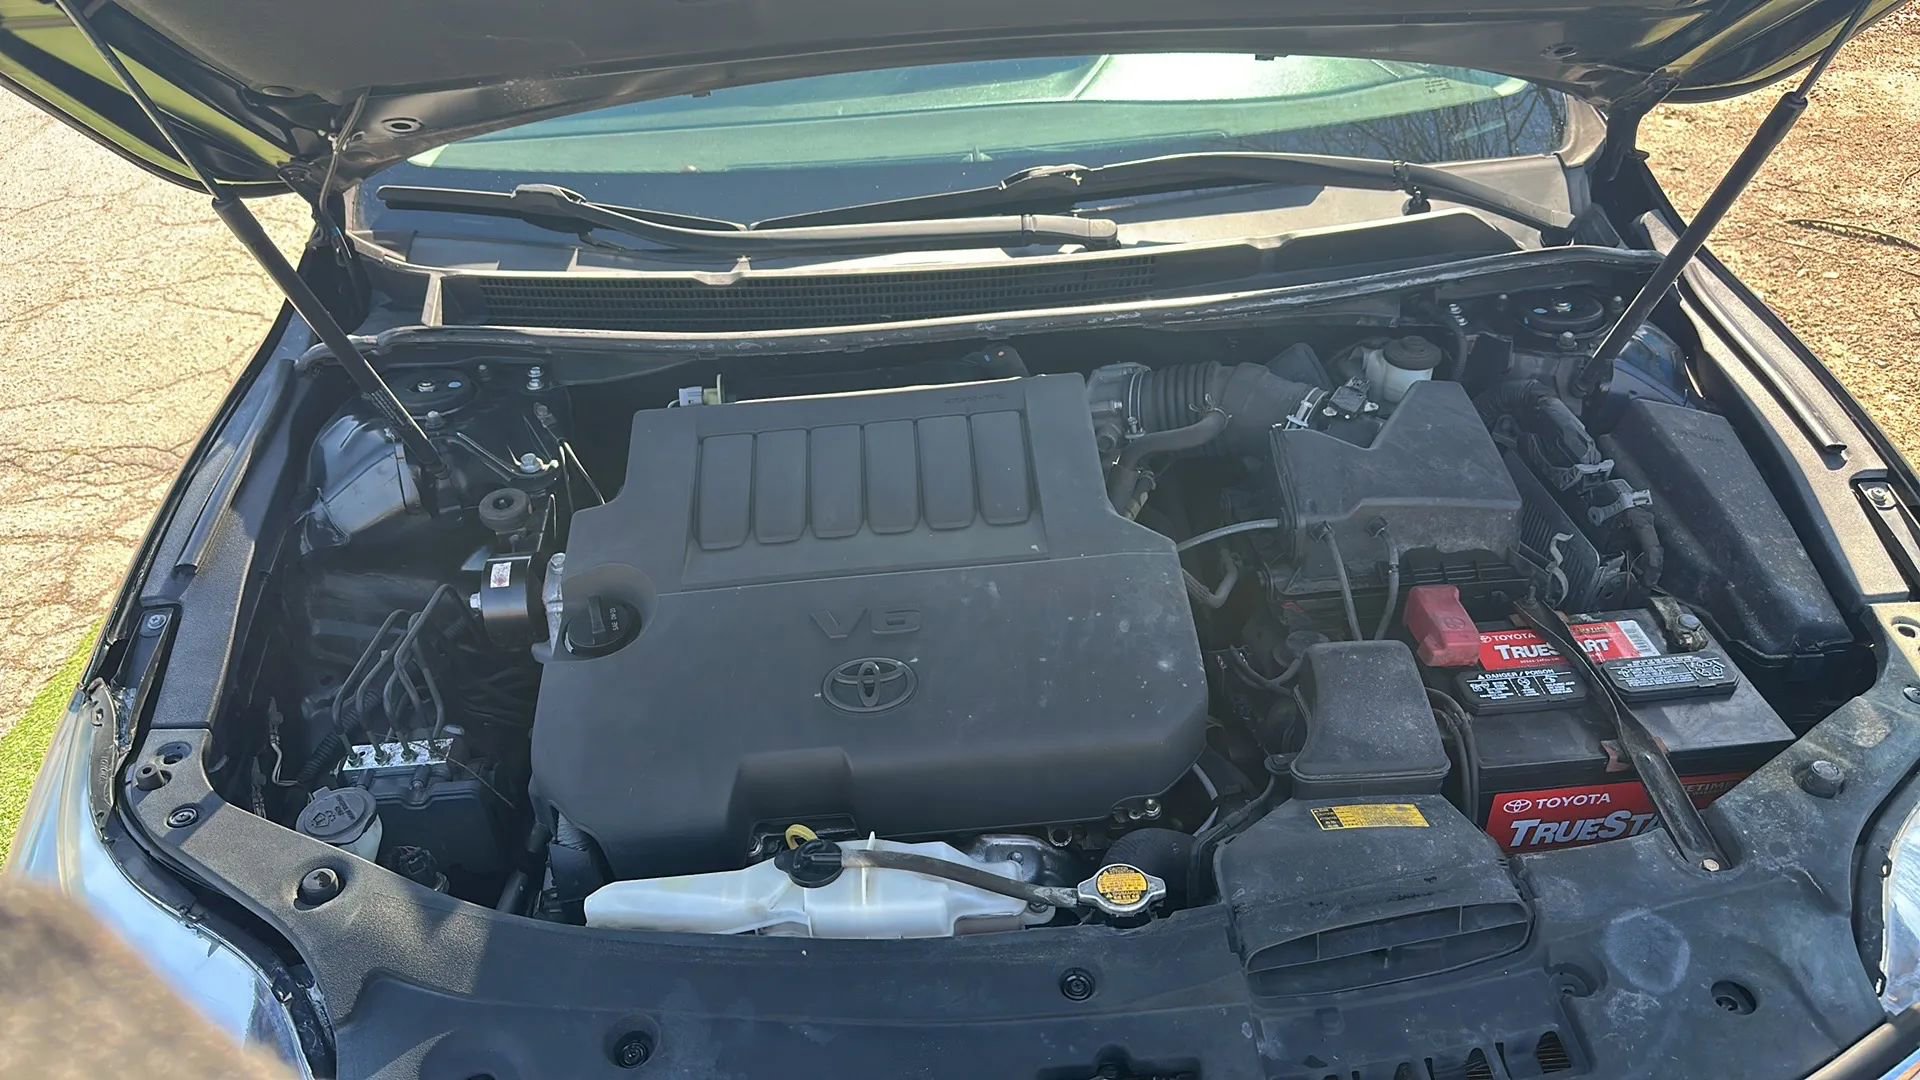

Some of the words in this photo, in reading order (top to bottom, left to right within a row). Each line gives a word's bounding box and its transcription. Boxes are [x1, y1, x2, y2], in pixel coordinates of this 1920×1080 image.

[808, 607, 921, 639] V6
[1491, 632, 1537, 641] TOYOTA
[1485, 671, 1518, 679] DANGER
[1525, 668, 1555, 676] POISON
[1536, 793, 1611, 809] TOYOTA
